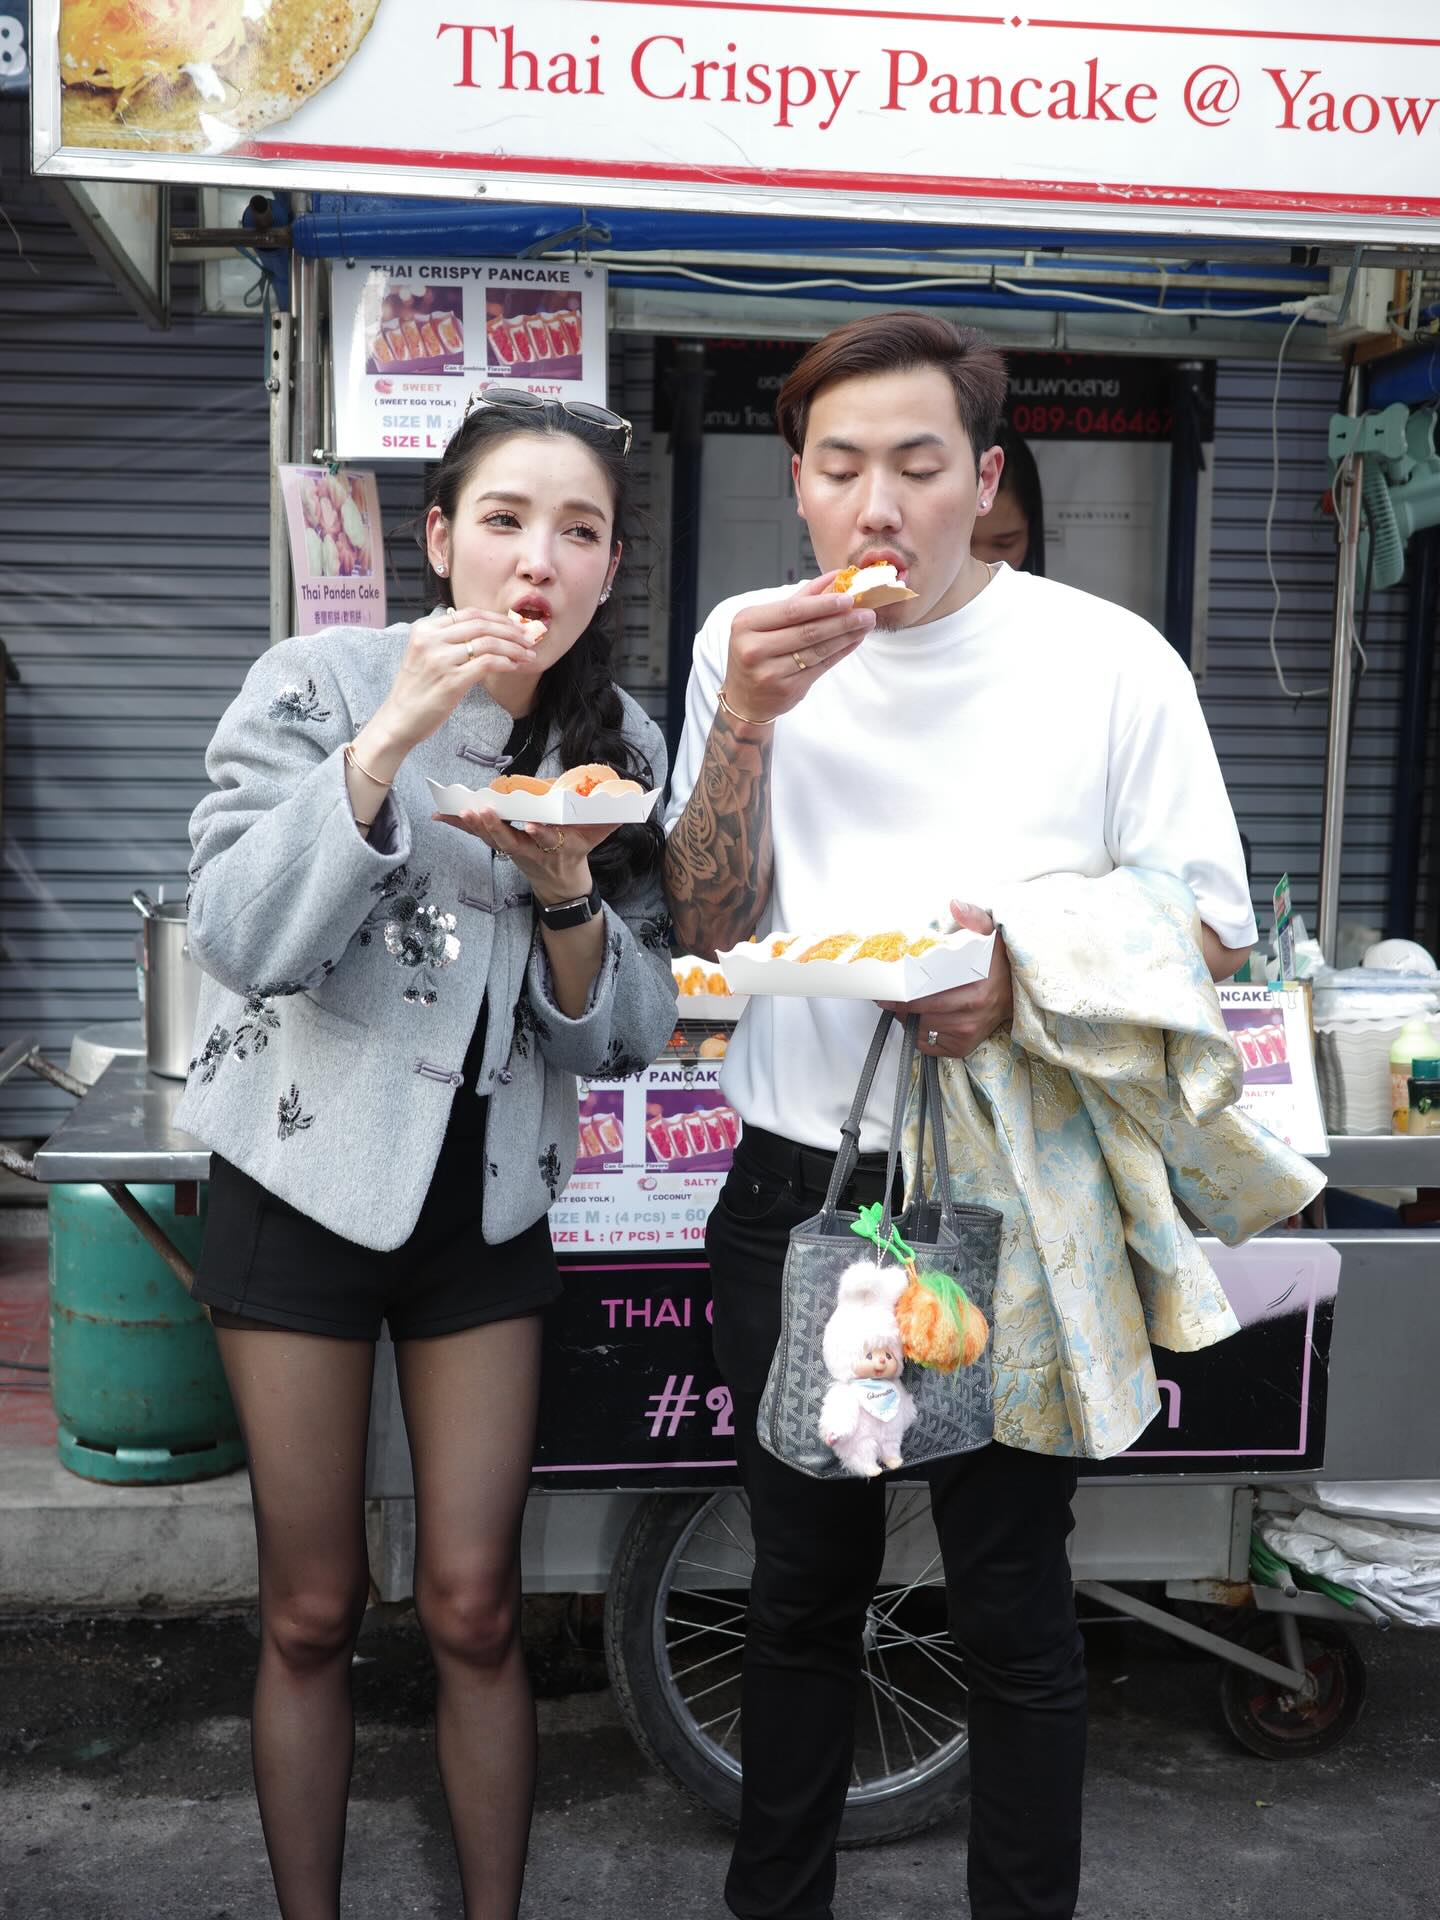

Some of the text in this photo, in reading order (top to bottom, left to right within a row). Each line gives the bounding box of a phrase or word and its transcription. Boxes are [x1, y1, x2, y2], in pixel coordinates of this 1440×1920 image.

[437, 22, 1440, 136] Thai Crispy Pancake @ Yaow
[371, 265, 570, 284] THAI CRISPY PANCAKE
[402, 383, 442, 392] SWEET
[527, 384, 562, 394] SALTY
[382, 415, 420, 428] SIZE
[426, 415, 442, 428] M
[382, 435, 420, 448] SIZE
[426, 434, 437, 448] L
[302, 584, 380, 600] Thai Panden Cake
[1219, 991, 1272, 1002] NCAKE
[650, 1070, 720, 1084] PANCAK
[683, 1178, 718, 1188] SALTY
[589, 1195, 610, 1203] YOLK
[653, 1193, 692, 1201] COCONUT
[585, 1211, 600, 1224] M
[615, 1211, 629, 1225] (4
[634, 1211, 666, 1225] PCS)
[685, 1208, 707, 1222] 60
[551, 1231, 578, 1243] IZE
[584, 1230, 594, 1242] L
[609, 1231, 623, 1245] (7
[628, 1231, 660, 1243] PCS)
[601, 1298, 691, 1328] THAI
